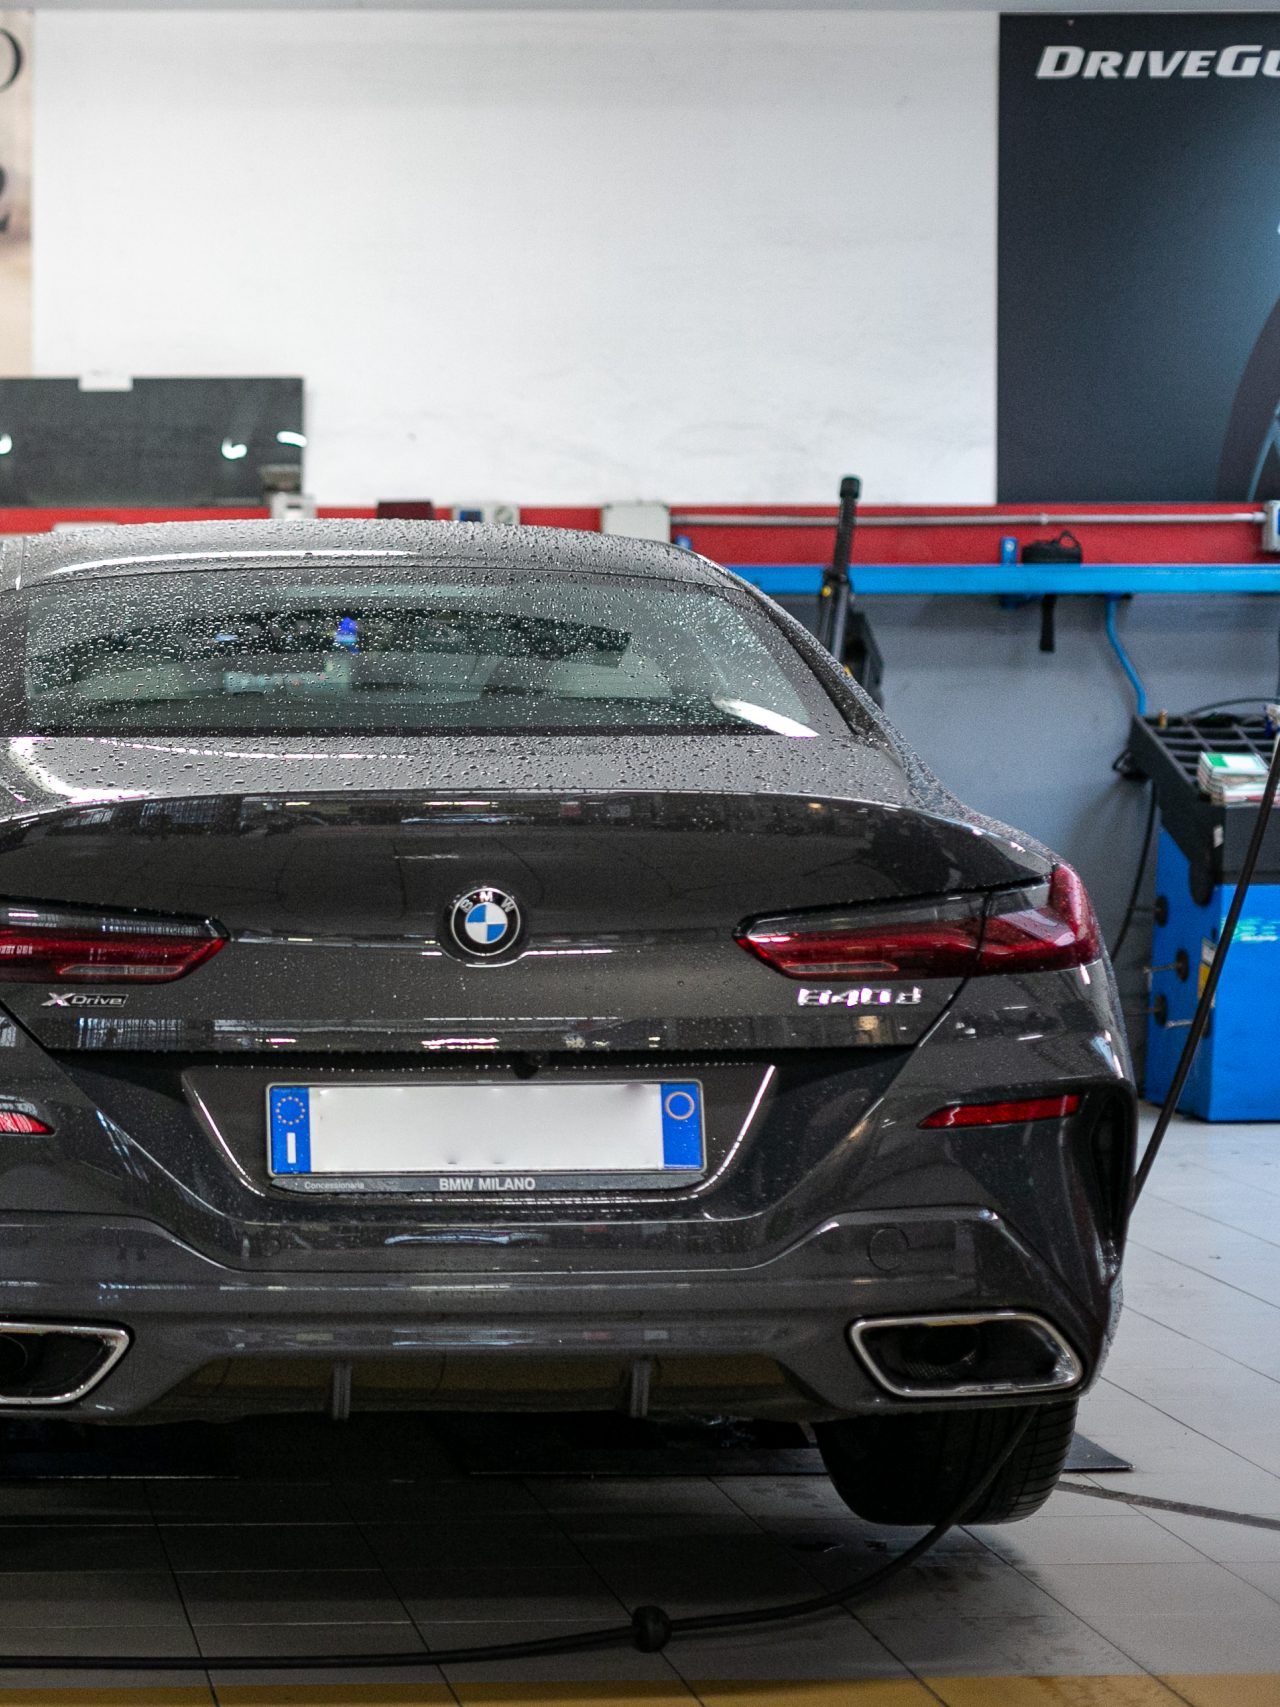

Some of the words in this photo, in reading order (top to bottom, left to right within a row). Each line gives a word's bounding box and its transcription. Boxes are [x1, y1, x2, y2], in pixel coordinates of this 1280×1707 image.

[459, 891, 516, 914] BMW
[303, 1180, 366, 1190] Concessionaria
[439, 1177, 475, 1191] BMW
[477, 1177, 536, 1191] MILANO
